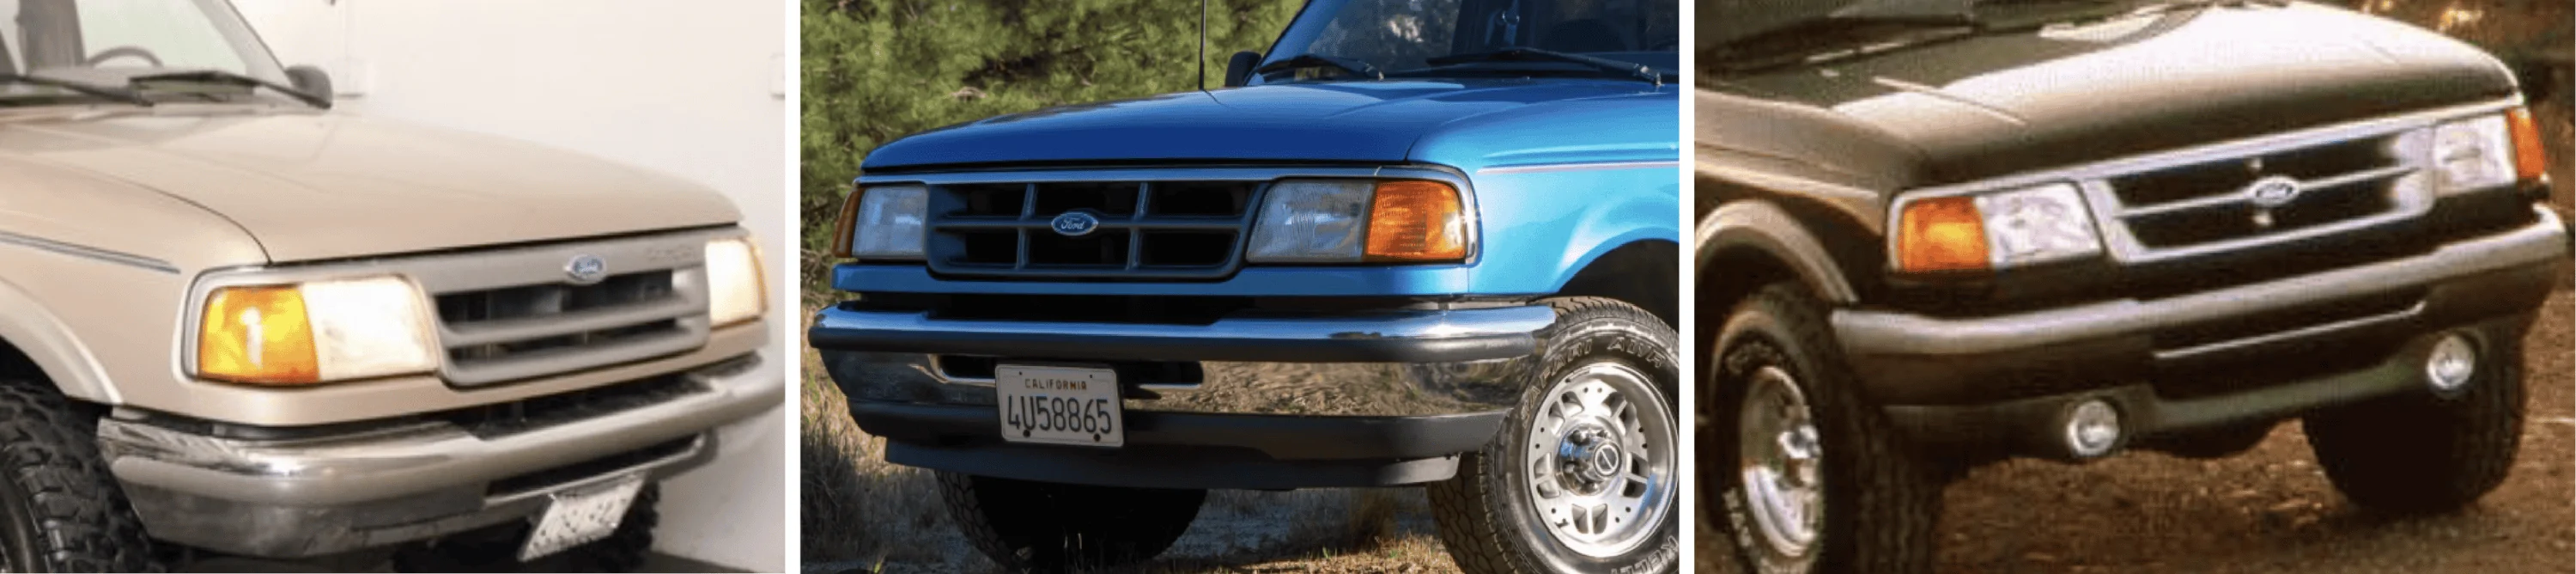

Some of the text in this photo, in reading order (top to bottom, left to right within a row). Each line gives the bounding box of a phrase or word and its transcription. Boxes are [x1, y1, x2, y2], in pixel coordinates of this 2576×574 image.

[1060, 217, 1084, 229] Ford
[1024, 378, 1087, 390] CALIFORNIA
[1007, 394, 1112, 434] 4U58865
